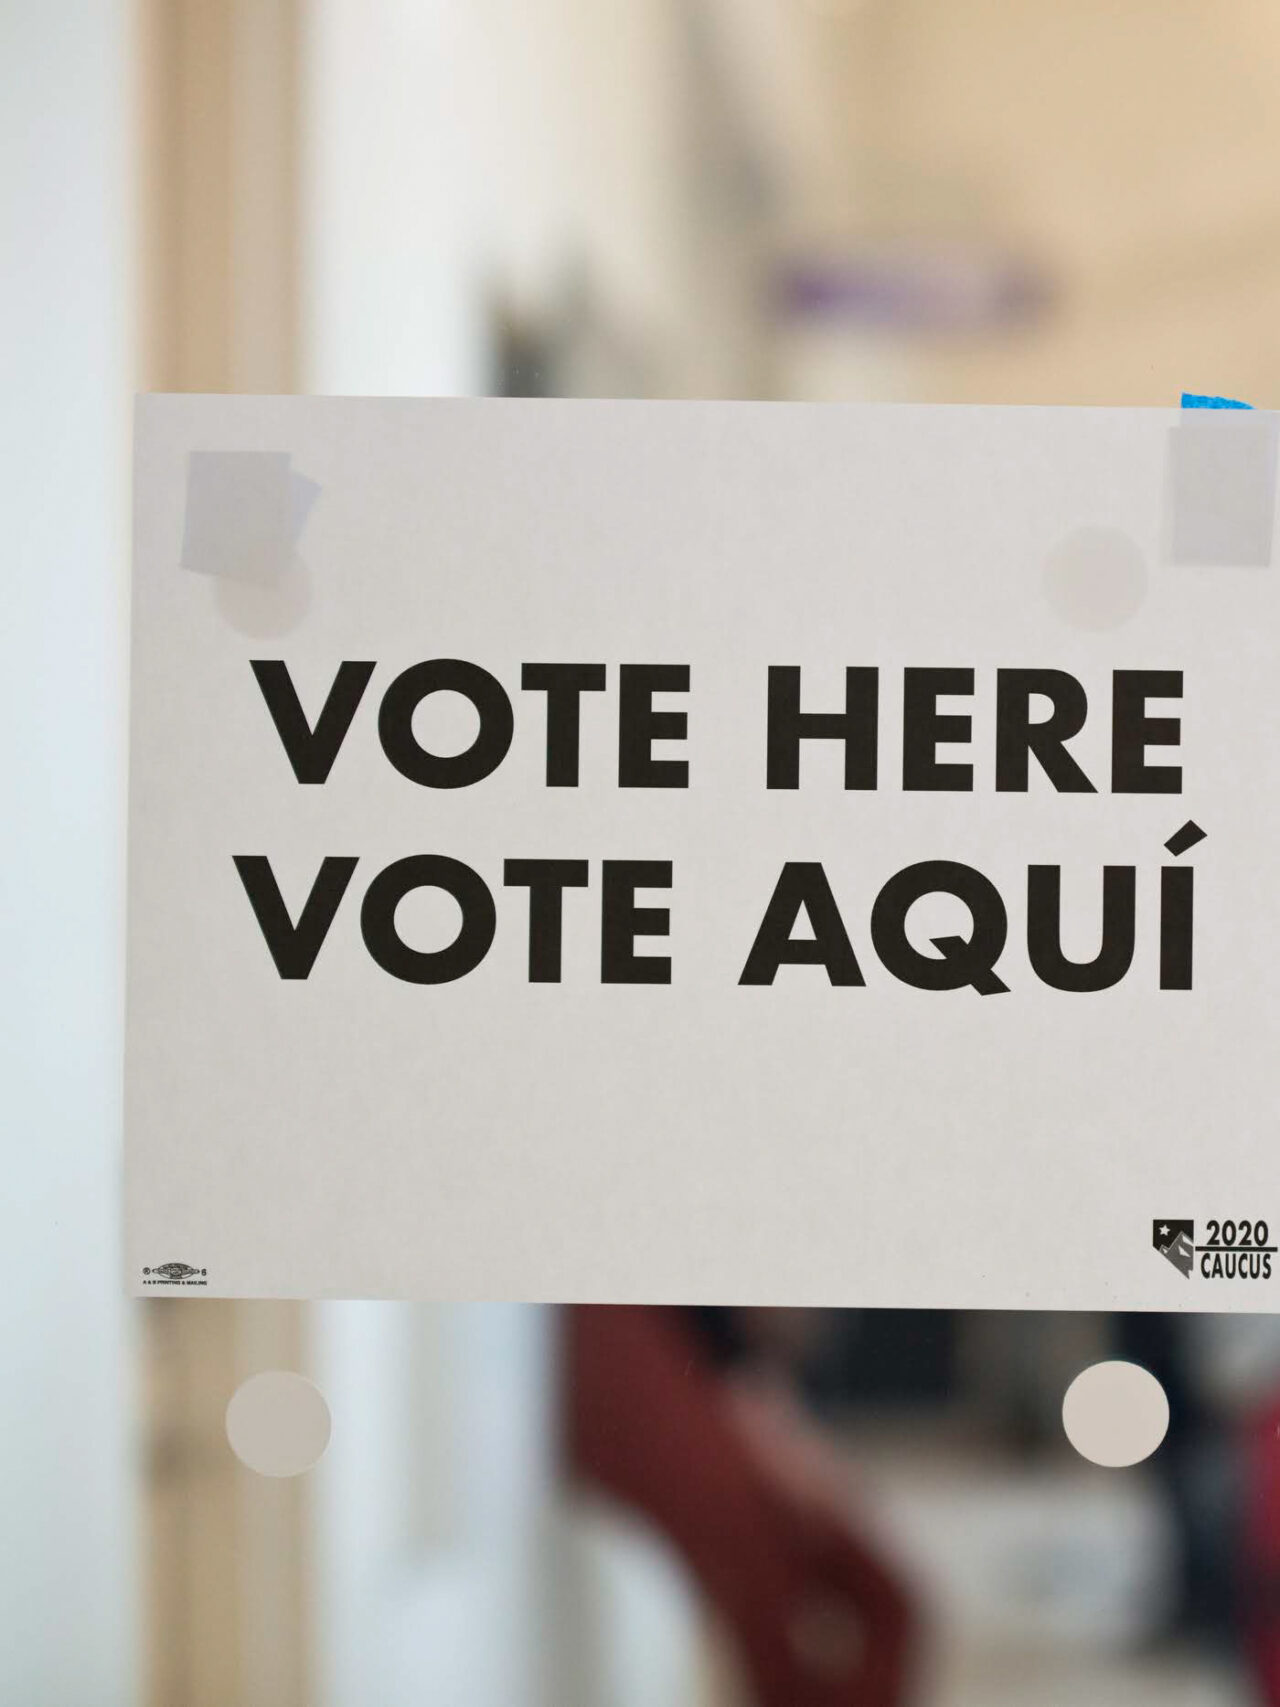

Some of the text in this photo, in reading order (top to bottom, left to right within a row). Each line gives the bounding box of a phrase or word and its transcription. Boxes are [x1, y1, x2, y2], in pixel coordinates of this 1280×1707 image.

[250, 659, 1183, 795] VOTE HERE
[232, 820, 1207, 996] VOTE AQUÍ
[1201, 1253, 1271, 1279] CAUCUS
[1206, 1220, 1268, 1246] 2020
